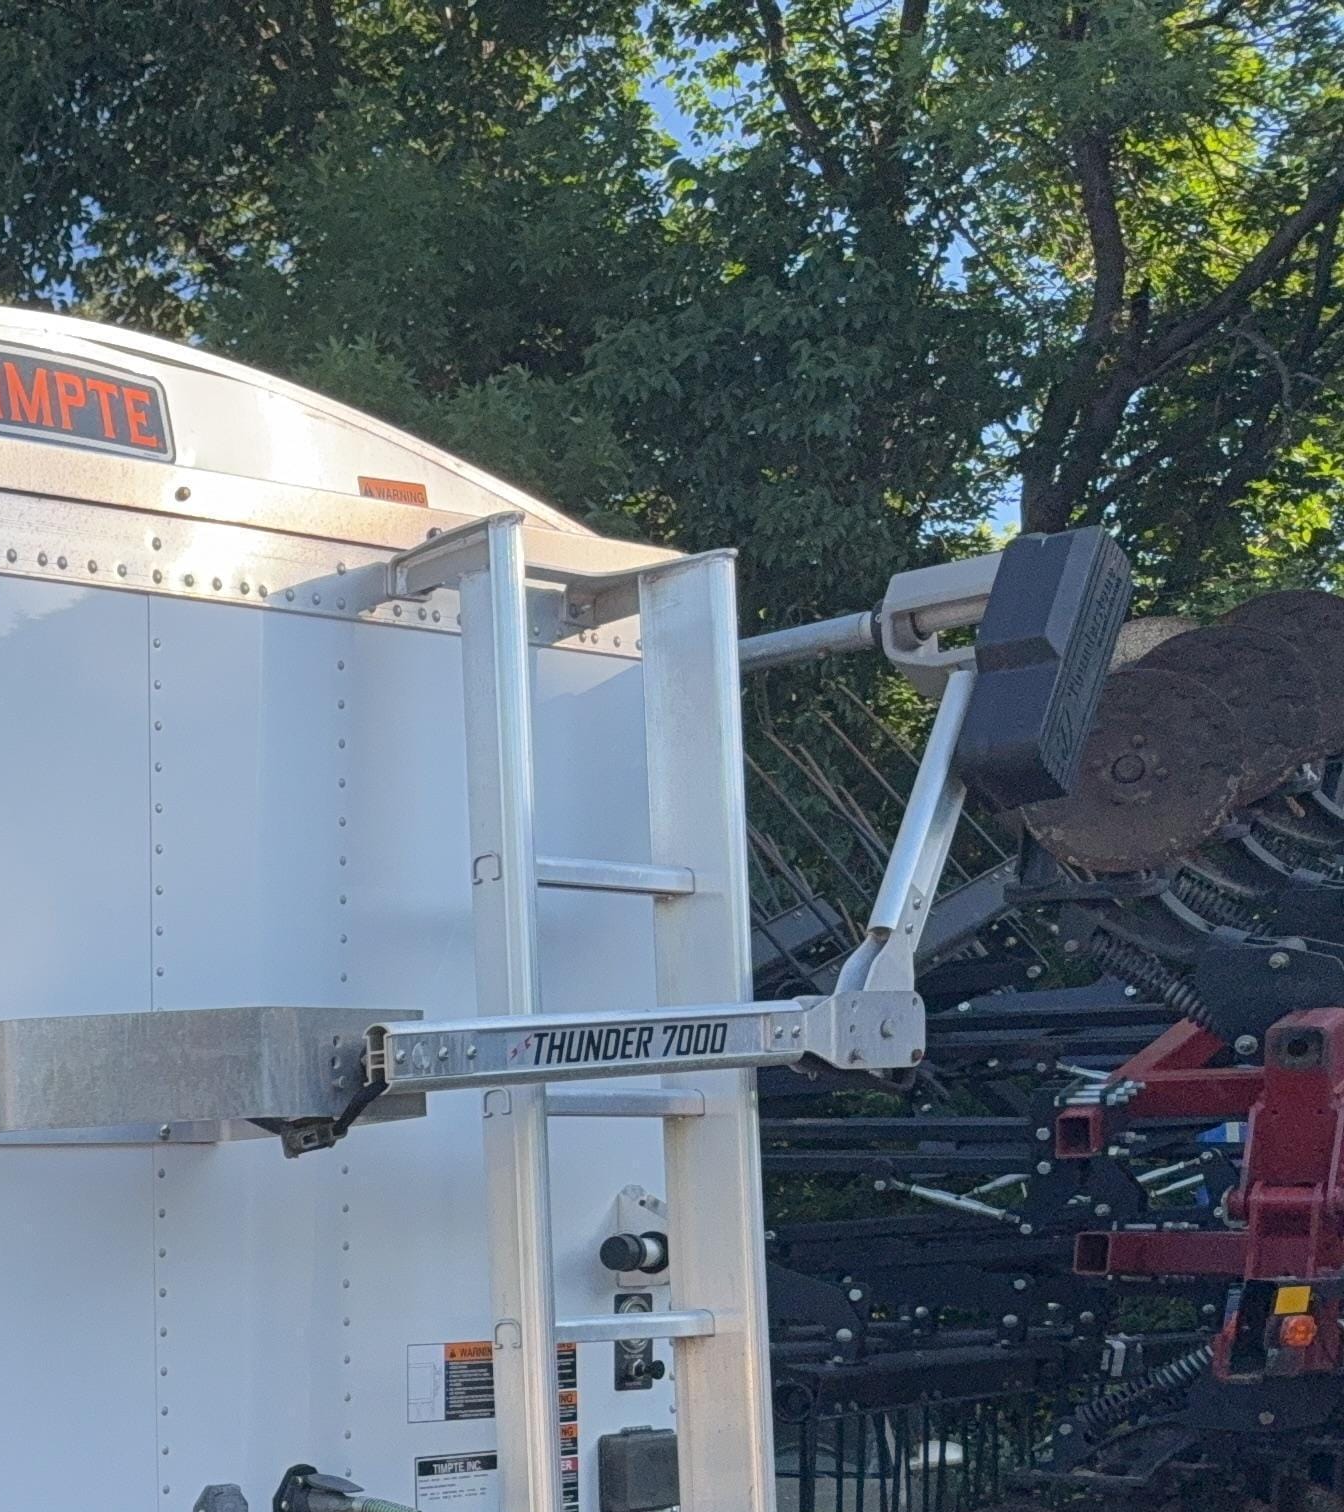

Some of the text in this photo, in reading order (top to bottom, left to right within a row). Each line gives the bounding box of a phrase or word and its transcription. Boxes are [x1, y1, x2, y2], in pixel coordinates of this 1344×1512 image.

[533, 1022, 728, 1065] THUNDER 7000
[432, 1462, 465, 1475] TIMPTE
[466, 1460, 482, 1472] INC.
